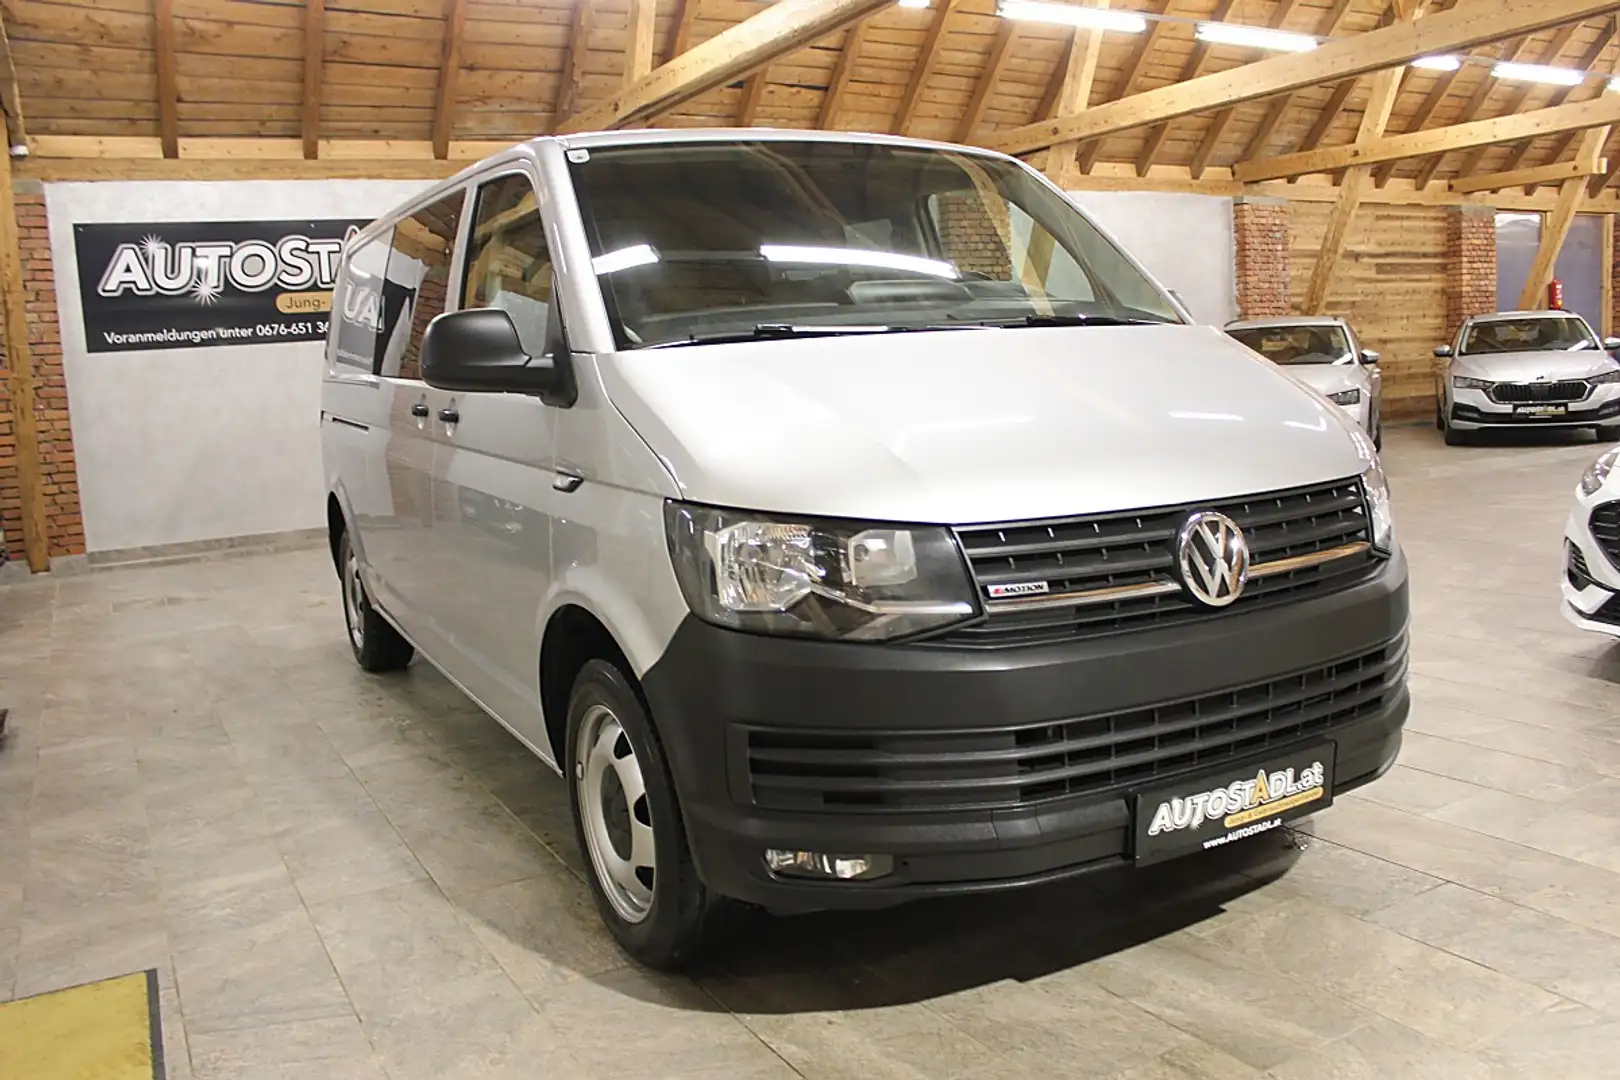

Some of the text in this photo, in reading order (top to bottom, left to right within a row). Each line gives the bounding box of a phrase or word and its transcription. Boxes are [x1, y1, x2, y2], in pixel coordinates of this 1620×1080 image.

[286, 296, 327, 311] Jung-
[103, 328, 217, 345] Voranmeldungen
[220, 325, 253, 338] unter
[256, 322, 312, 336] 0676-651
[1148, 761, 1324, 836] AUTOSTADL.at
[1203, 818, 1282, 849] www.AUTOSTADL.at
